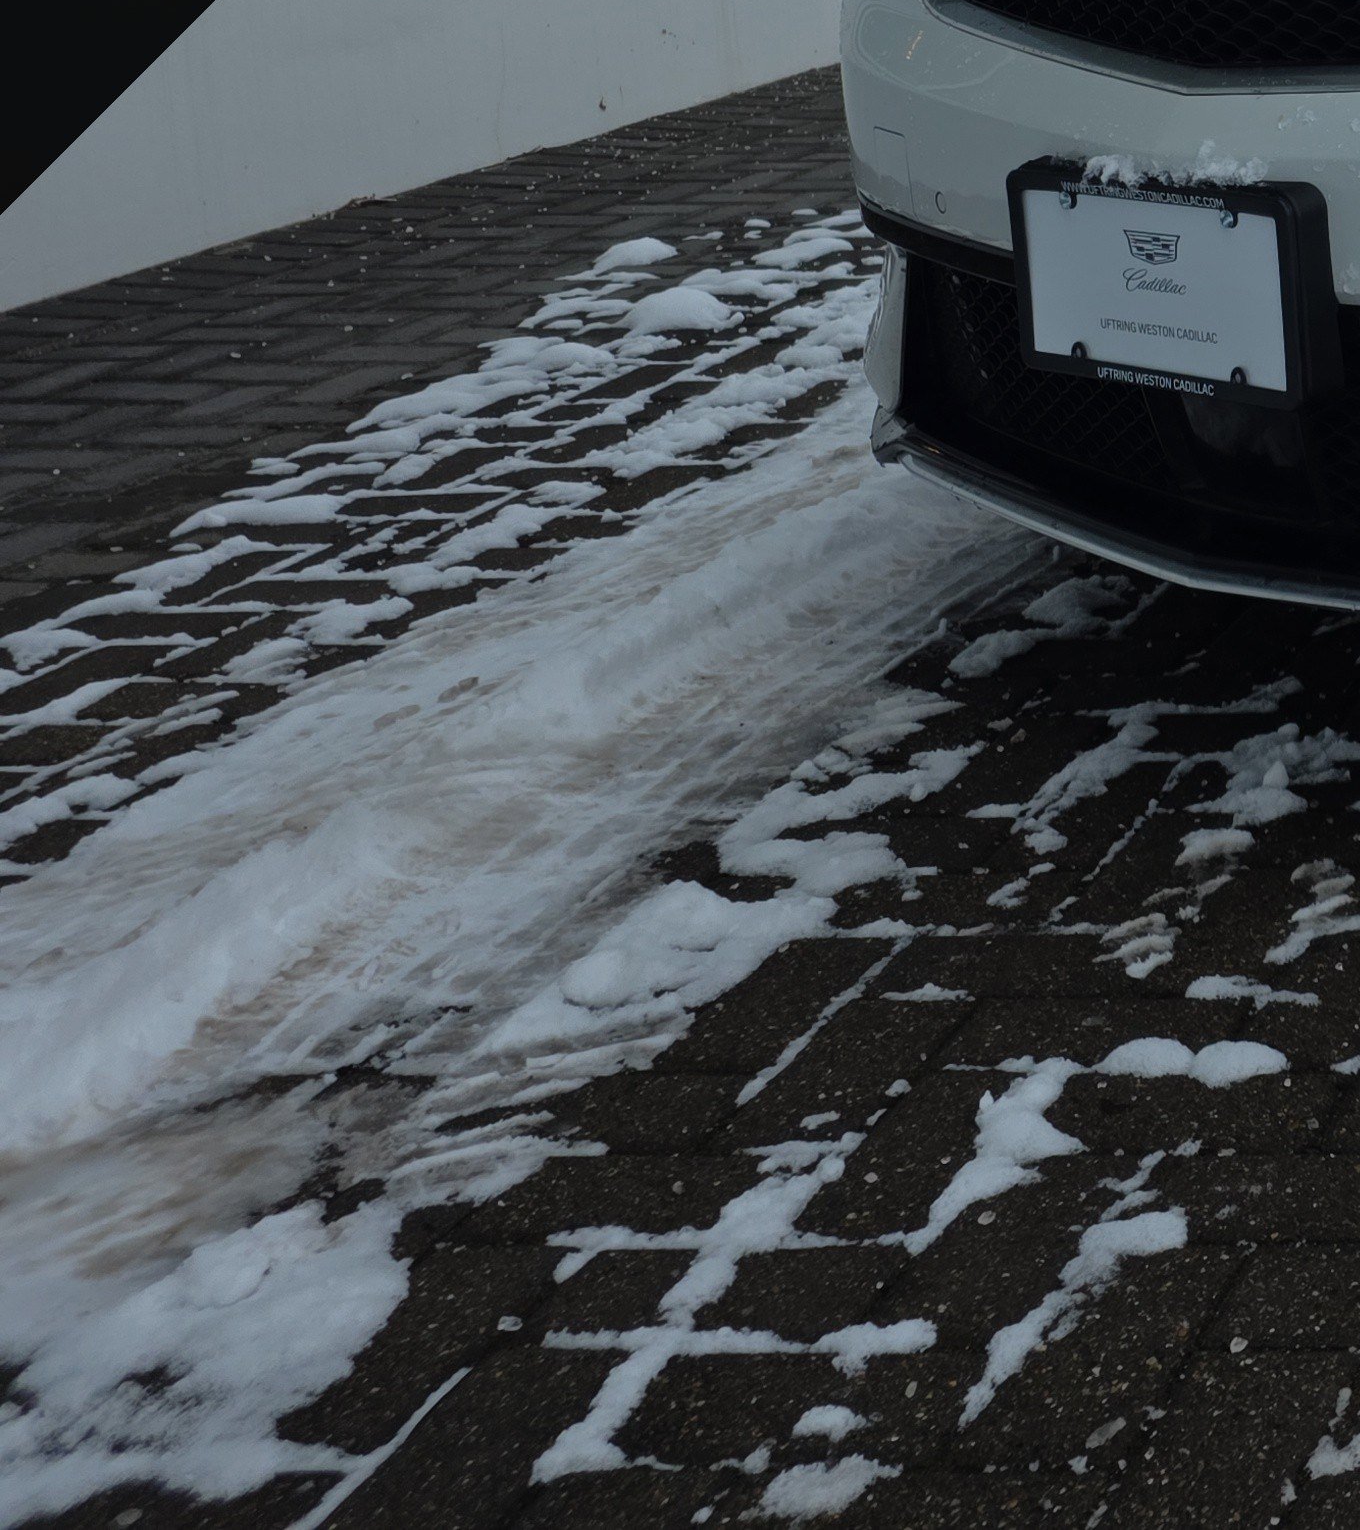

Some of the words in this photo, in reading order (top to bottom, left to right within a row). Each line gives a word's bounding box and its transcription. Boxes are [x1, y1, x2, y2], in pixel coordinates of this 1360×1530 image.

[1122, 267, 1187, 296] Cadillac
[1100, 317, 1137, 333] UFTRING
[1138, 323, 1175, 339] WESTON
[1176, 328, 1218, 345] CADILLAC
[1097, 366, 1133, 383] UFTRING
[1135, 372, 1172, 390] WESTON
[1173, 378, 1215, 397] CADILLAC
